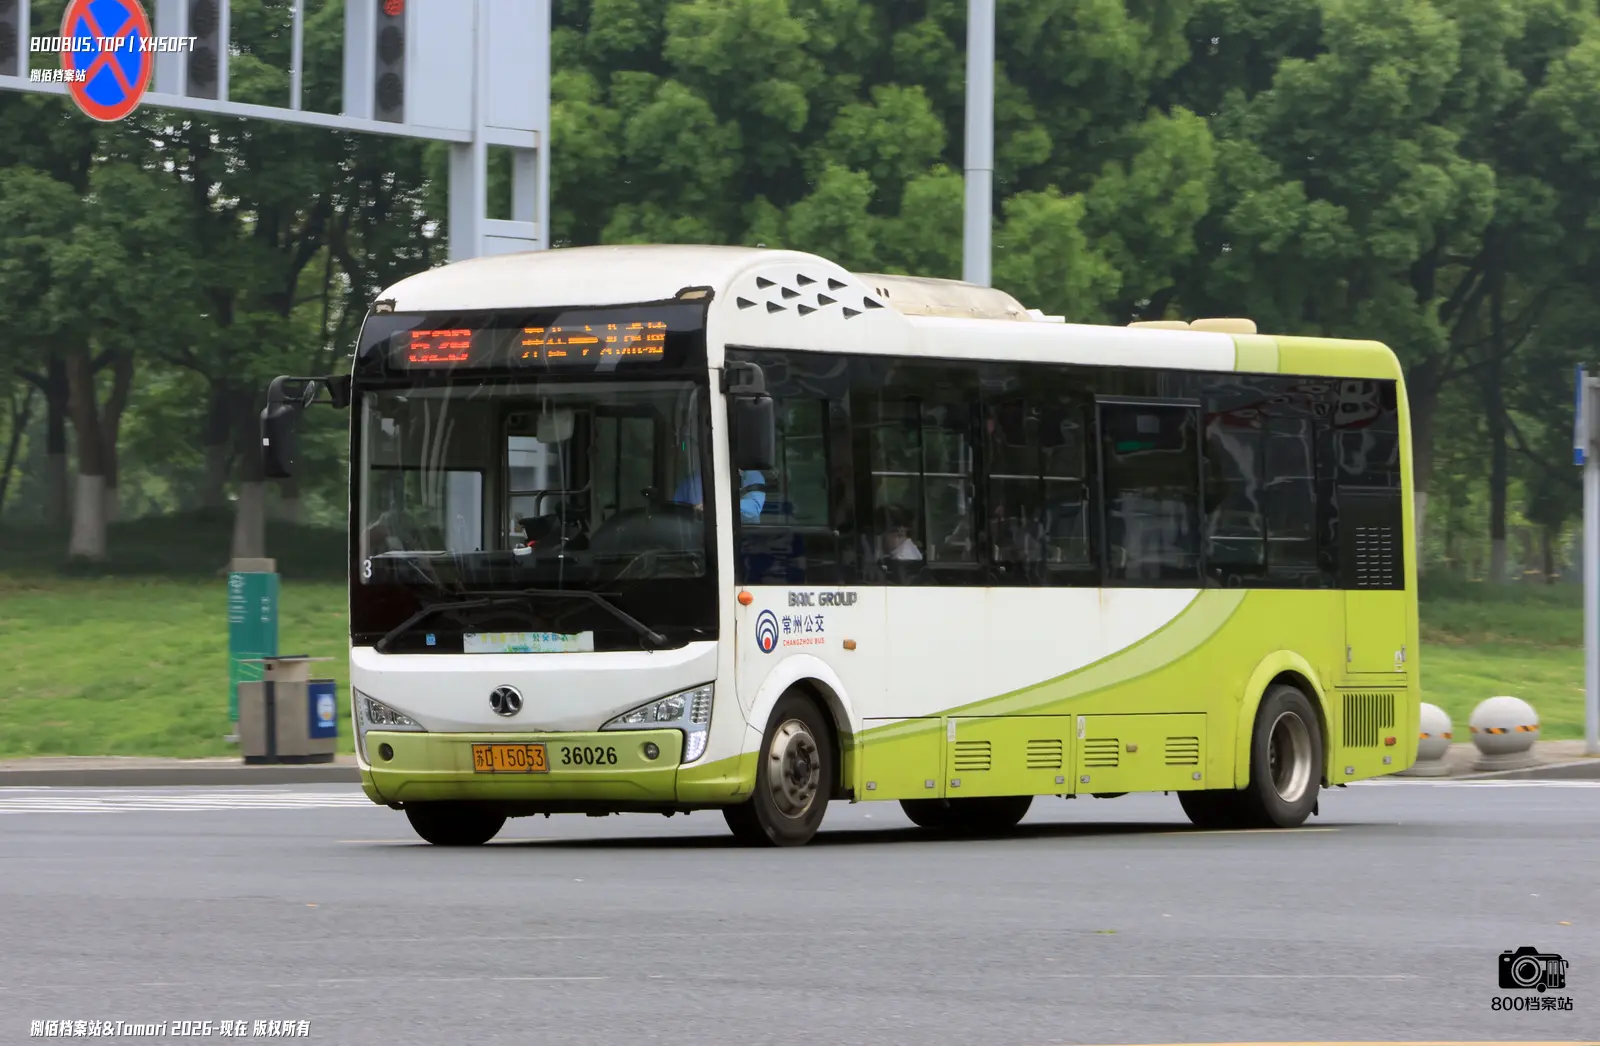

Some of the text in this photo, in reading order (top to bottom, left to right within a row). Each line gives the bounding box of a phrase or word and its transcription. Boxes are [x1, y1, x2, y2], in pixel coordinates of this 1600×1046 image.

[363, 559, 373, 579] 3
[788, 591, 858, 607] BAIC GROUP
[781, 614, 825, 635] 常州公交
[783, 637, 825, 647] CHANGZHOU BUS
[560, 746, 618, 766] 36026
